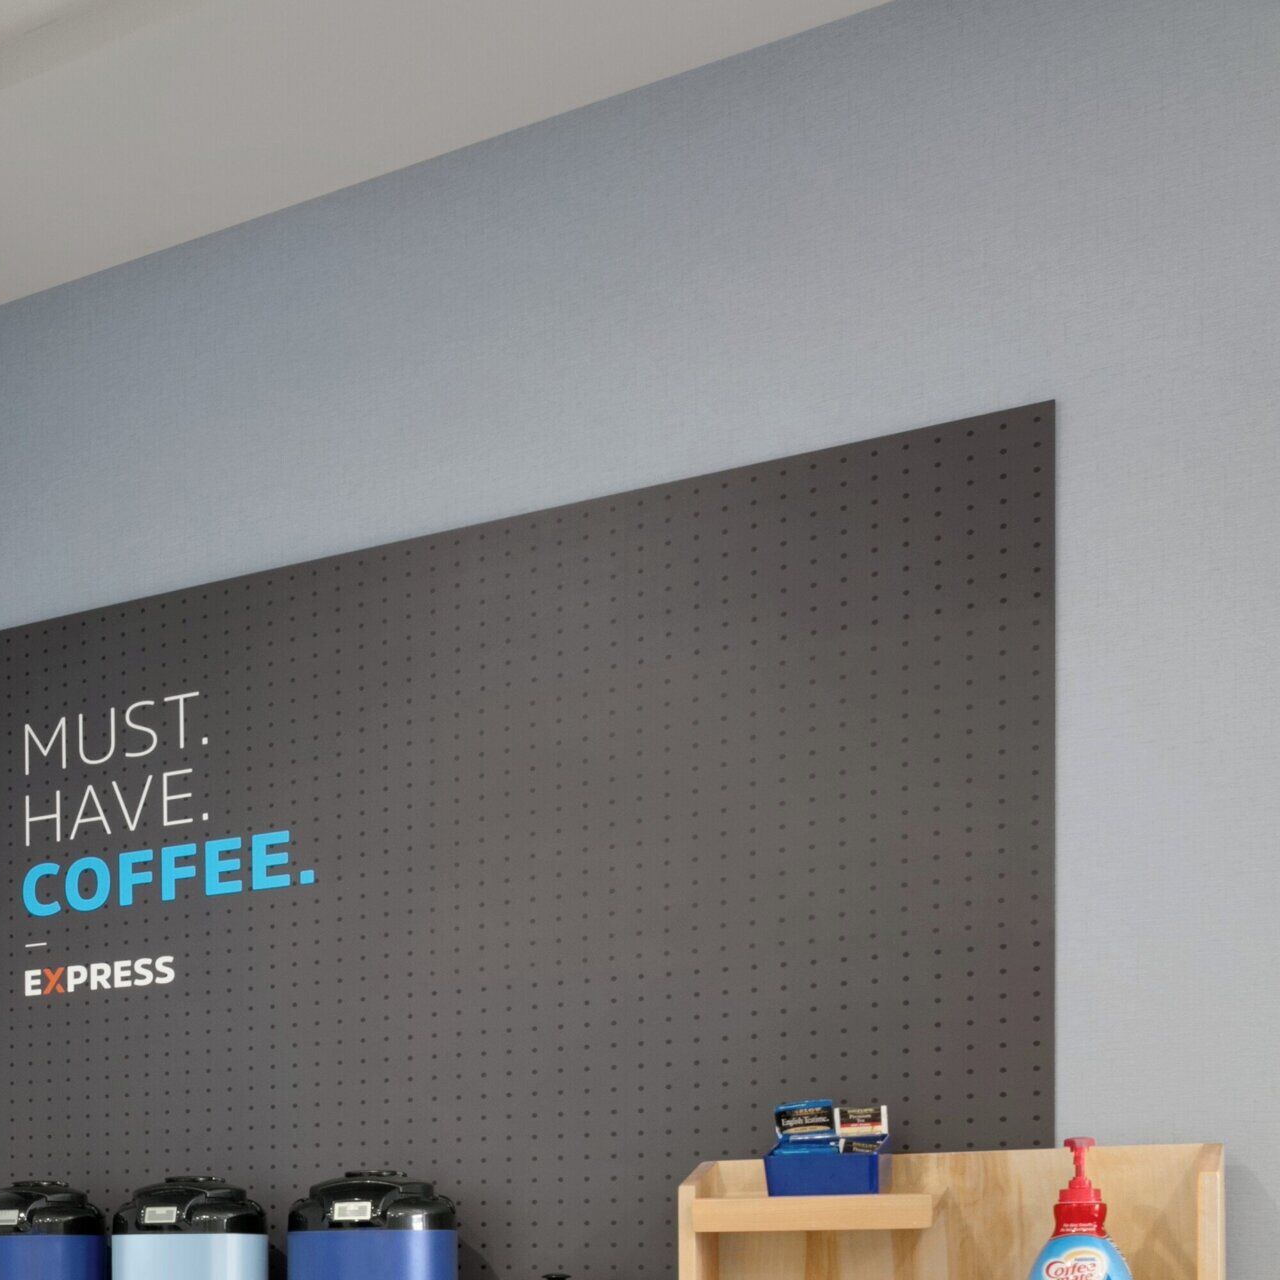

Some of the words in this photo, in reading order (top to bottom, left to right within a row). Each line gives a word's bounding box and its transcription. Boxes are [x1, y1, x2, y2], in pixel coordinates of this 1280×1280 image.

[24, 691, 210, 776] MUST.
[25, 768, 210, 847] HAVE.
[22, 830, 316, 918] COFFEE.
[24, 955, 176, 998] EXPRESS
[1045, 1260, 1096, 1279] Coffee
